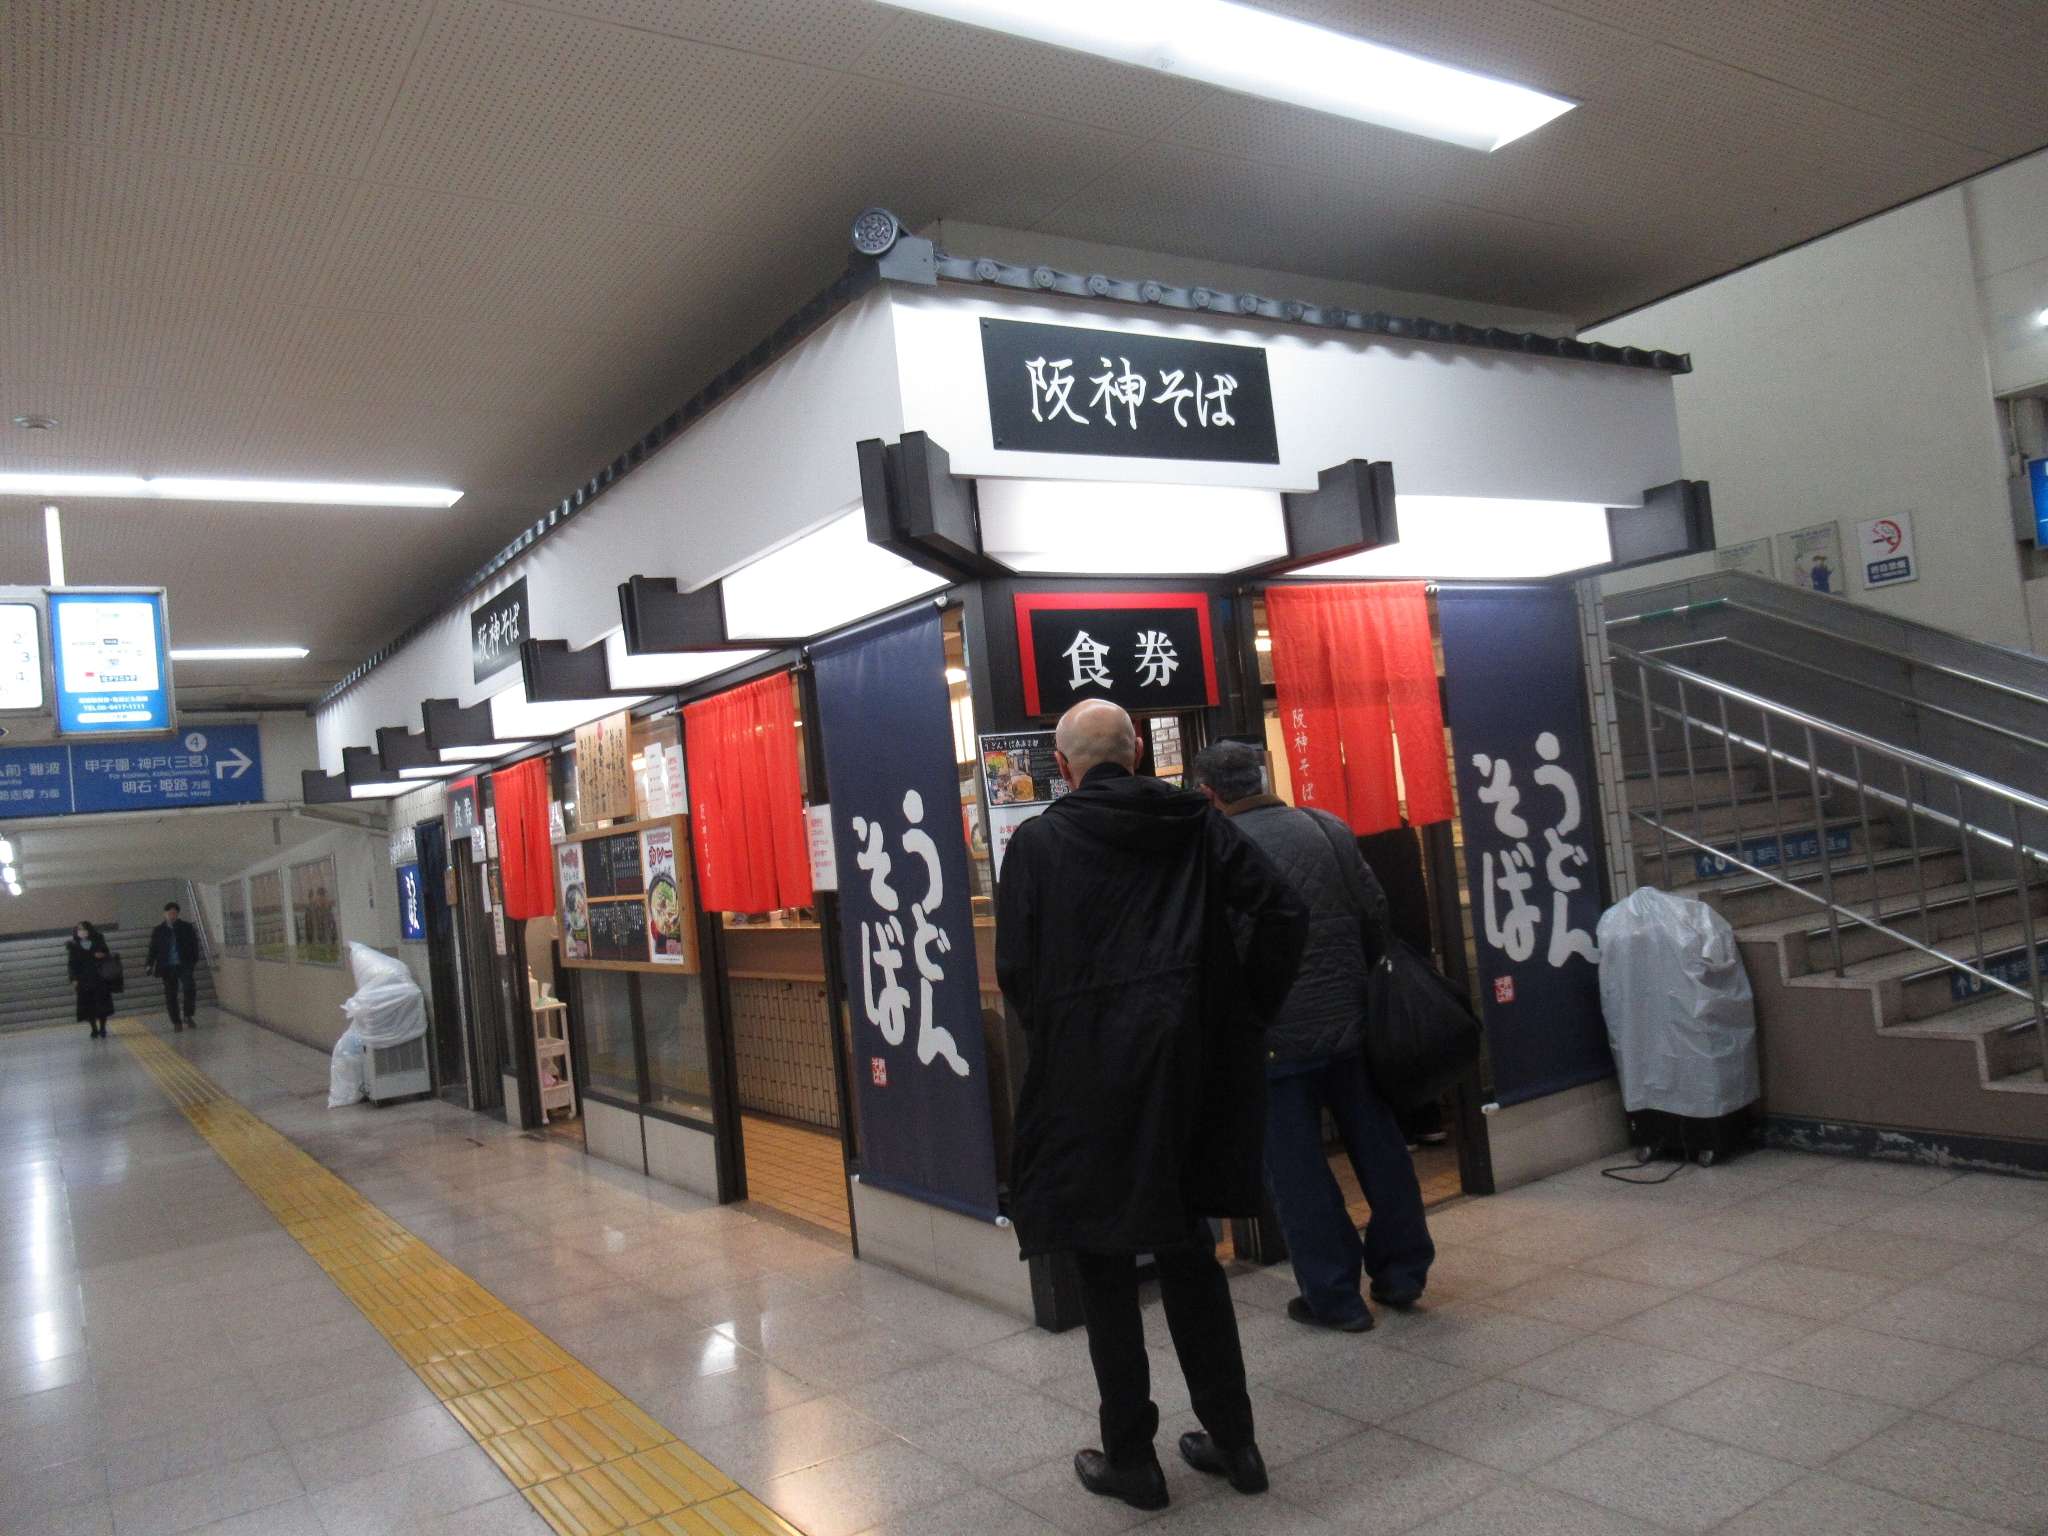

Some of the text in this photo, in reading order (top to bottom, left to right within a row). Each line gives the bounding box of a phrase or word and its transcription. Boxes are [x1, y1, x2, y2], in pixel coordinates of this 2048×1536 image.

[1024, 355, 1239, 431] 阪神そば
[477, 600, 521, 663] 阪神そば
[1061, 629, 1180, 691] 食券
[122, 778, 189, 794] 明石・姫路
[1290, 707, 1315, 801] 阪神そば
[1471, 752, 1542, 962] そば
[1533, 731, 1600, 968] うどん
[852, 816, 911, 1046] そば
[901, 789, 970, 1077] うどん
